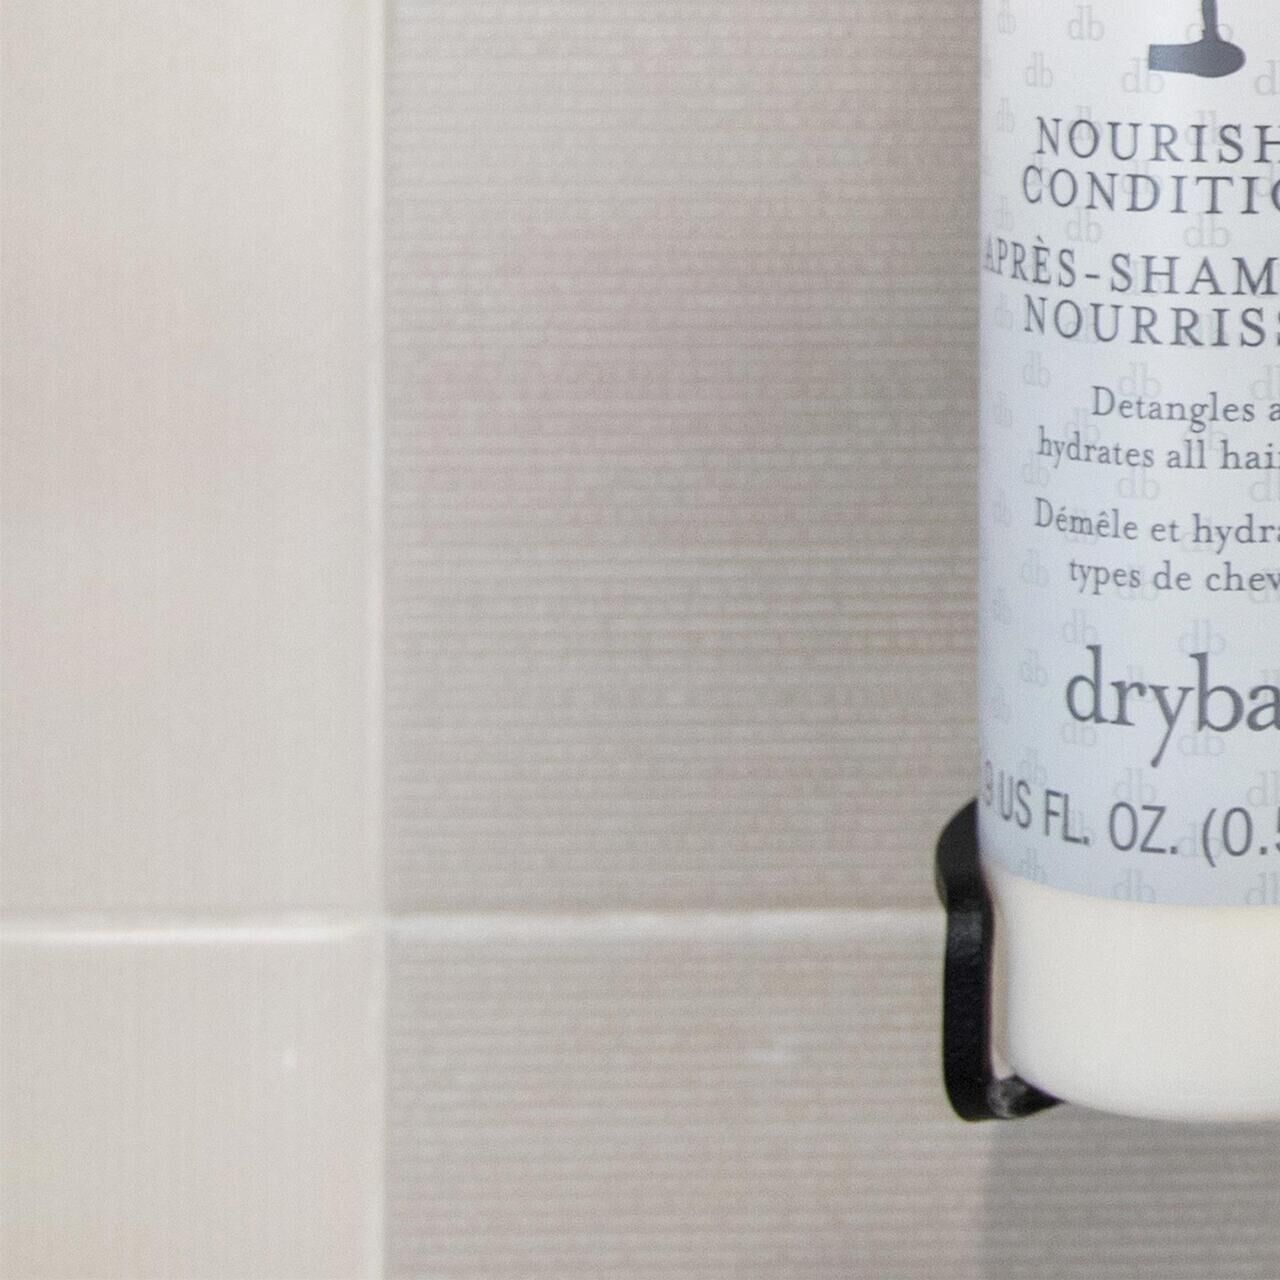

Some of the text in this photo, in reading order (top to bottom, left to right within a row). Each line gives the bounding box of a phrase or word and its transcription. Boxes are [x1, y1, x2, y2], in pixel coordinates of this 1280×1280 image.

[1091, 385, 1256, 435] Detangles
[1036, 424, 1155, 469] hydrates
[1166, 438, 1207, 470] all
[1034, 496, 1139, 541] Démêle
[1149, 520, 1180, 544] et
[1068, 559, 1142, 596] types
[1151, 559, 1192, 592] de
[1000, 777, 1033, 830] US
[1044, 788, 1090, 846] FL.
[1108, 800, 1179, 855] OZ.
